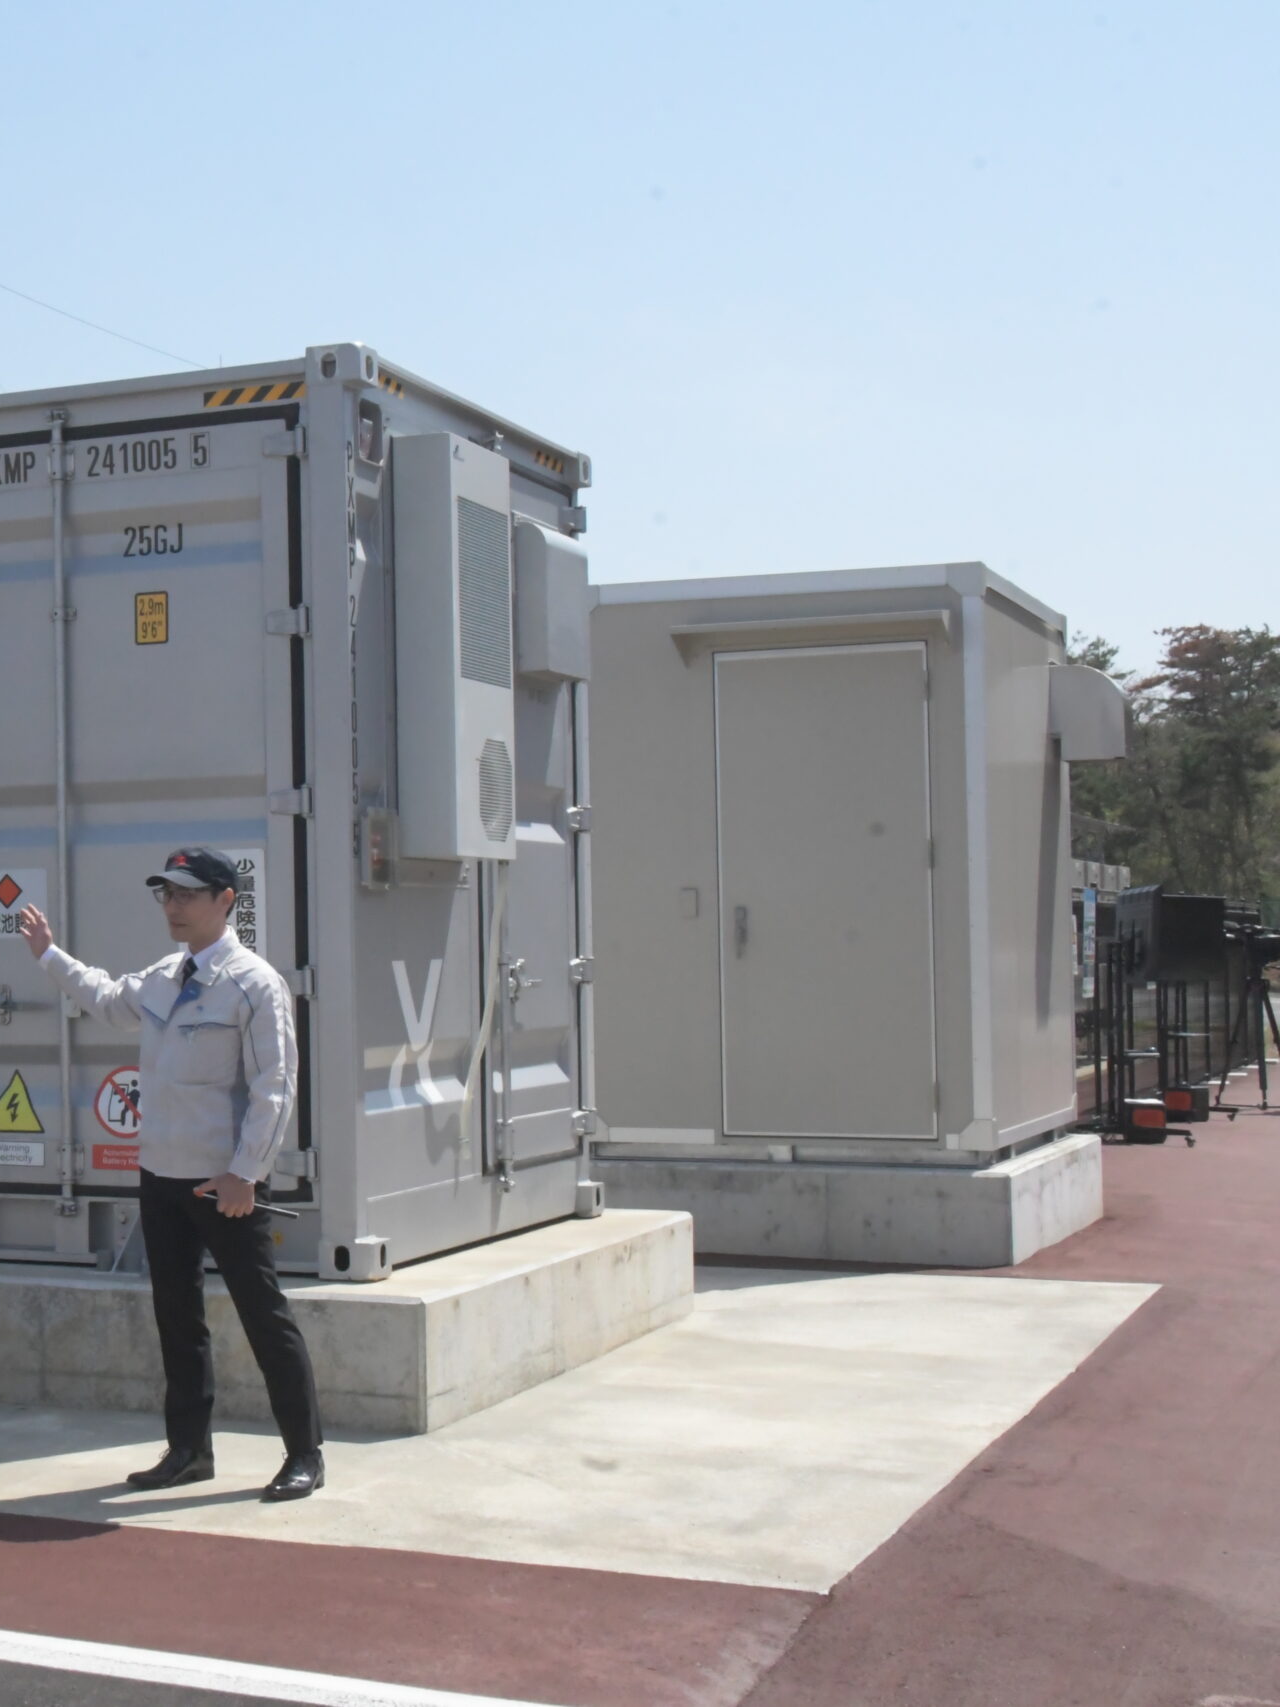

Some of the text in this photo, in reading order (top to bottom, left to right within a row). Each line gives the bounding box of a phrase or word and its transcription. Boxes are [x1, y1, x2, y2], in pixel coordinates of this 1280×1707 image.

[87, 438, 177, 478] 241005
[193, 434, 208, 467] 5
[346, 440, 355, 579] PXMP
[123, 522, 184, 558] 25GJ
